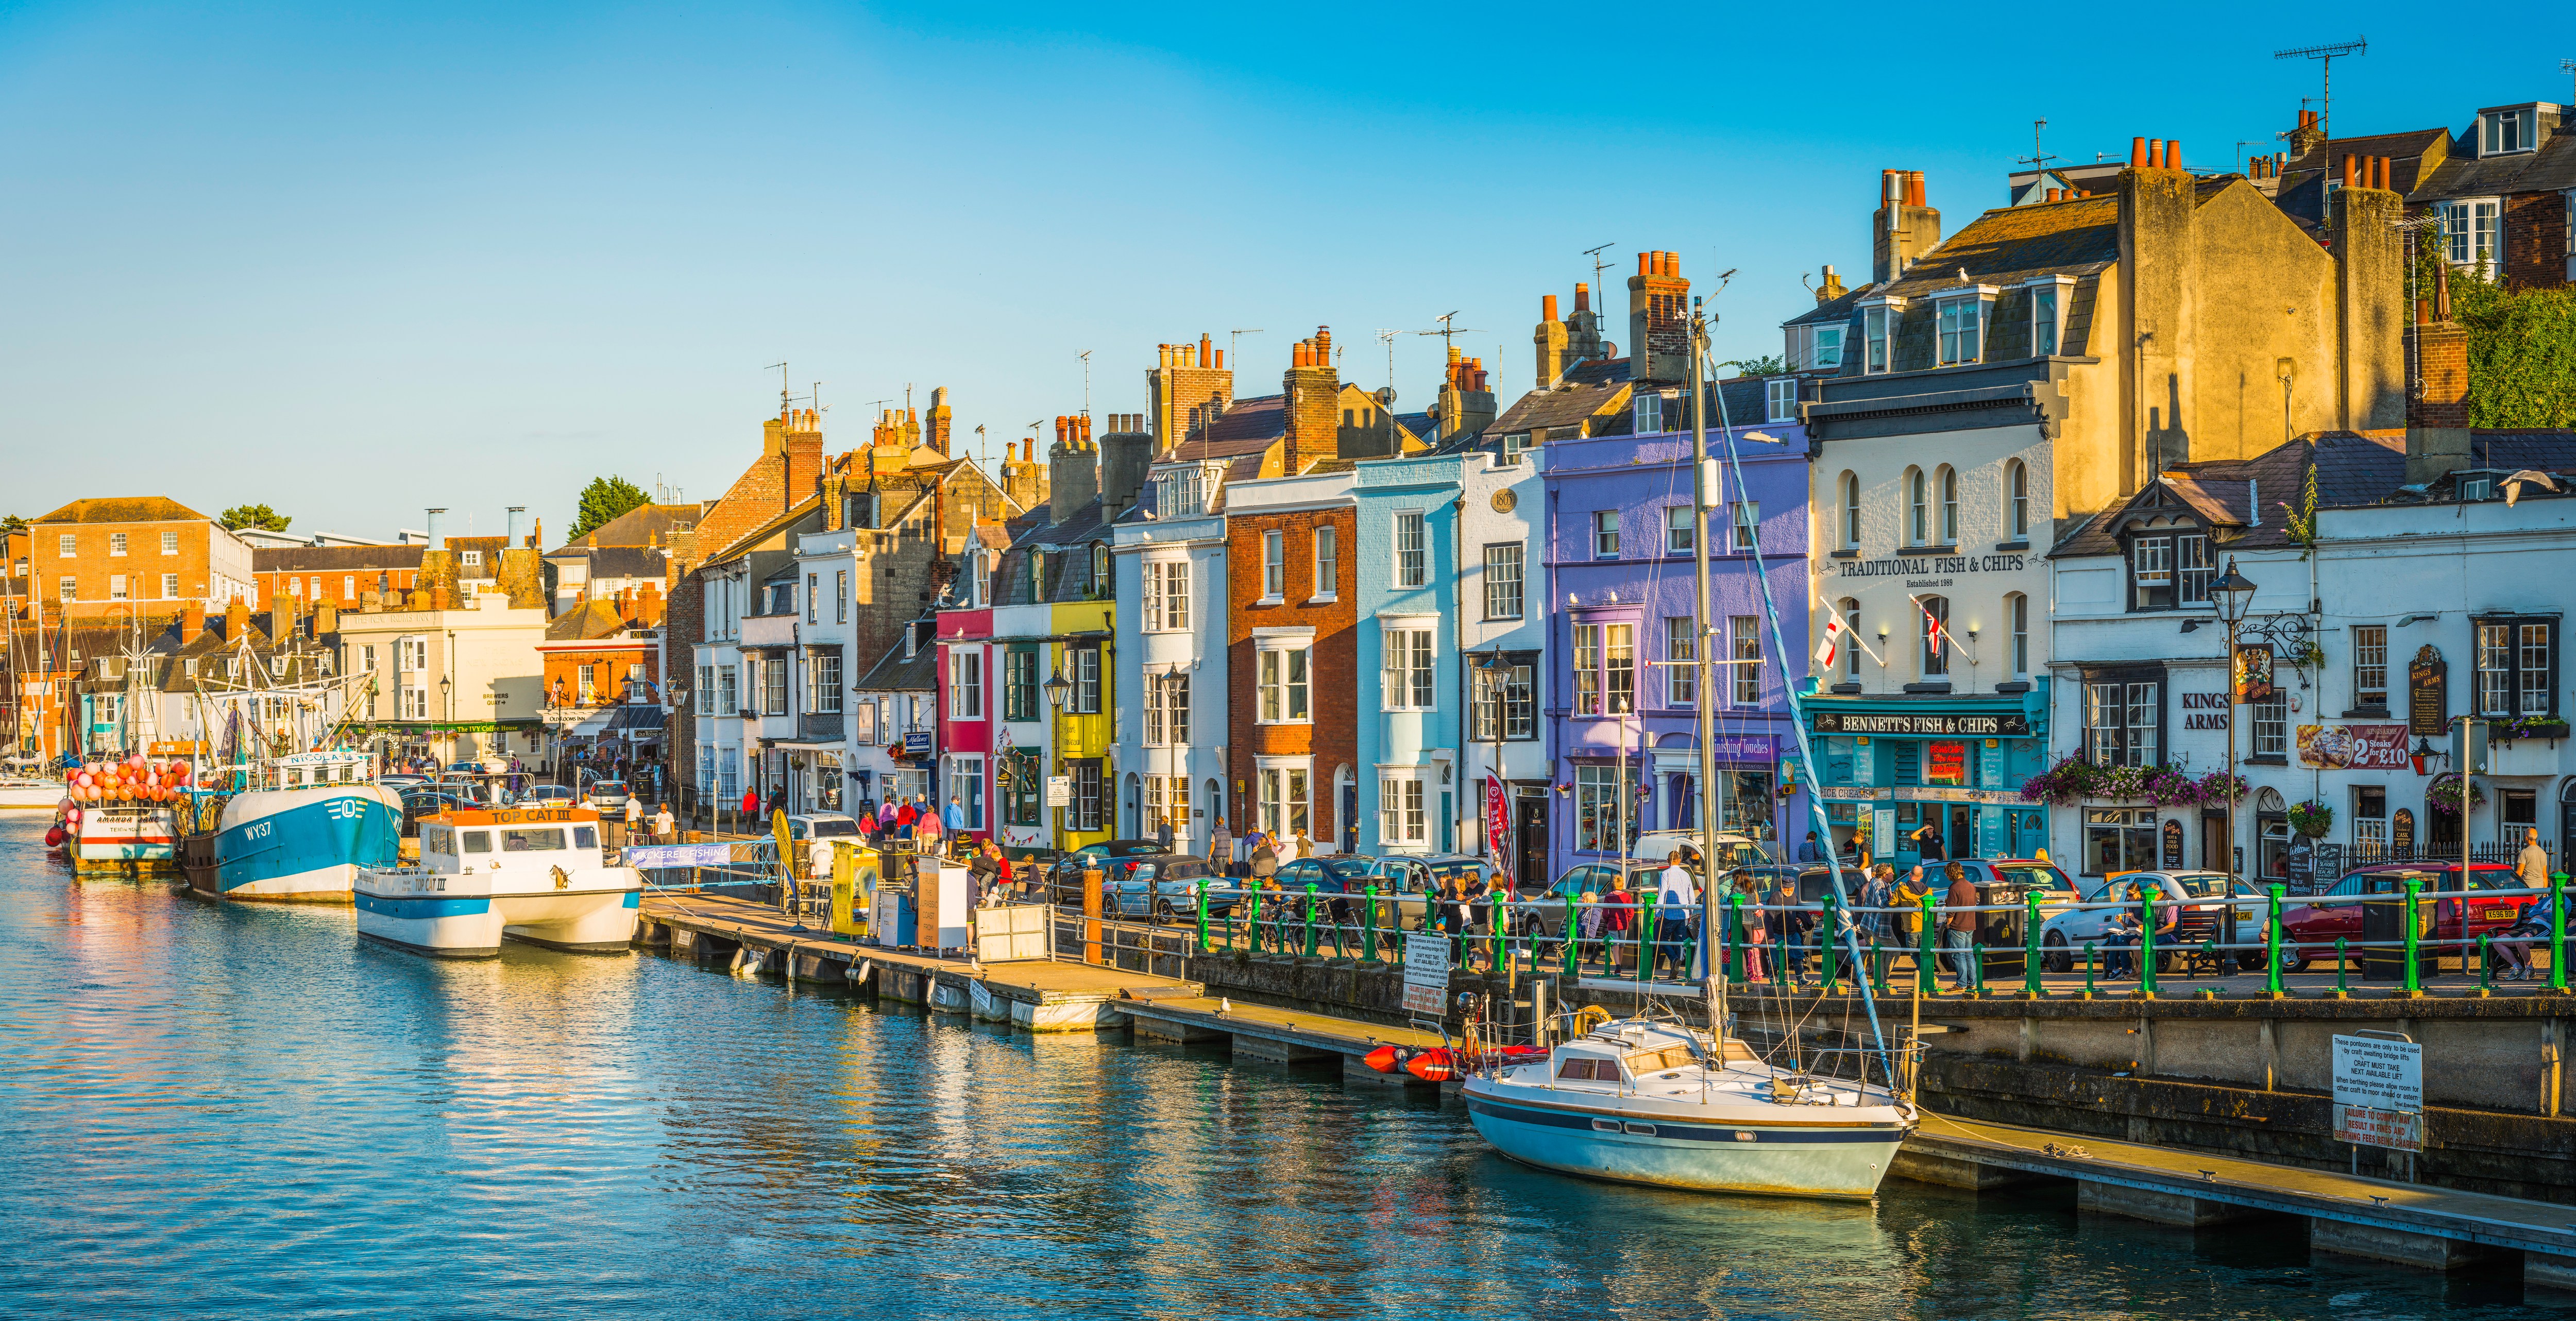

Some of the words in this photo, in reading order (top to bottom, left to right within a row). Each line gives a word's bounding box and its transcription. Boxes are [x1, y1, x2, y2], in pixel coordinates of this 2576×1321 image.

[1497, 494, 1512, 505] 1805
[1840, 558, 1928, 577] TRADITIONAL
[1935, 557, 1965, 573] FISH
[1970, 556, 1979, 572] &
[1982, 554, 2023, 571] CHIPS
[1907, 580, 1939, 588] Established
[1941, 579, 1953, 587] 1989
[370, 615, 386, 623] NEW
[2413, 669, 2430, 679] KINGS
[2239, 681, 2256, 693] KINGS
[2424, 676, 2439, 686] ARMS
[2255, 685, 2268, 696] ARMS
[2182, 693, 2229, 708] KINGS
[1842, 716, 1910, 732] BENNETT'S
[1913, 717, 1943, 733] FISH
[1946, 718, 1955, 733] &
[1958, 717, 1997, 733] CHIPS
[2184, 714, 2228, 729] ARMS
[907, 735, 928, 744] Mallams
[1715, 739, 1740, 754] inishing
[1743, 739, 1768, 754] Touches
[2354, 738, 2368, 764] 2
[291, 753, 352, 764] NICOLA-L
[2369, 748, 2379, 756] for
[2380, 749, 2406, 764] £10
[1824, 789, 1836, 797] ICE
[1839, 789, 1870, 798] CREAMS
[492, 812, 520, 823] TOP
[527, 810, 552, 821] CAT
[557, 810, 571, 820] III
[244, 821, 271, 841] WY37
[631, 851, 685, 860] MACKEREL
[689, 848, 728, 857] FISHING
[2290, 844, 2310, 856] Welcome
[415, 878, 425, 891] TOP
[426, 878, 436, 891] CAT
[437, 878, 446, 891] III
[837, 883, 847, 894] RIDE
[919, 900, 938, 908] JURASSIC
[2350, 1040, 2371, 1049] pontoons
[2364, 1050, 2382, 1059] awaiting
[2384, 1052, 2399, 1060] bridge
[2366, 1070, 2391, 1078] AVAILABLE
[2350, 1077, 2368, 1087] berthing
[2369, 1080, 2385, 1090] please
[2345, 1108, 2366, 1119] FAILURE
[2368, 1111, 2375, 1120] TO
[2377, 1112, 2396, 1123] COMPLY
[2399, 1114, 2411, 1125] MAY
[2348, 1120, 2367, 1130] RESULT
[2369, 1123, 2375, 1131] IN
[2377, 1124, 2392, 1134] FINES
[2394, 1126, 2405, 1136] AND
[2334, 1130, 2361, 1141] BERTHING
[2363, 1134, 2376, 1143] FEES
[2377, 1136, 2393, 1146] BEING
[2395, 1139, 2420, 1149] CHARGED
